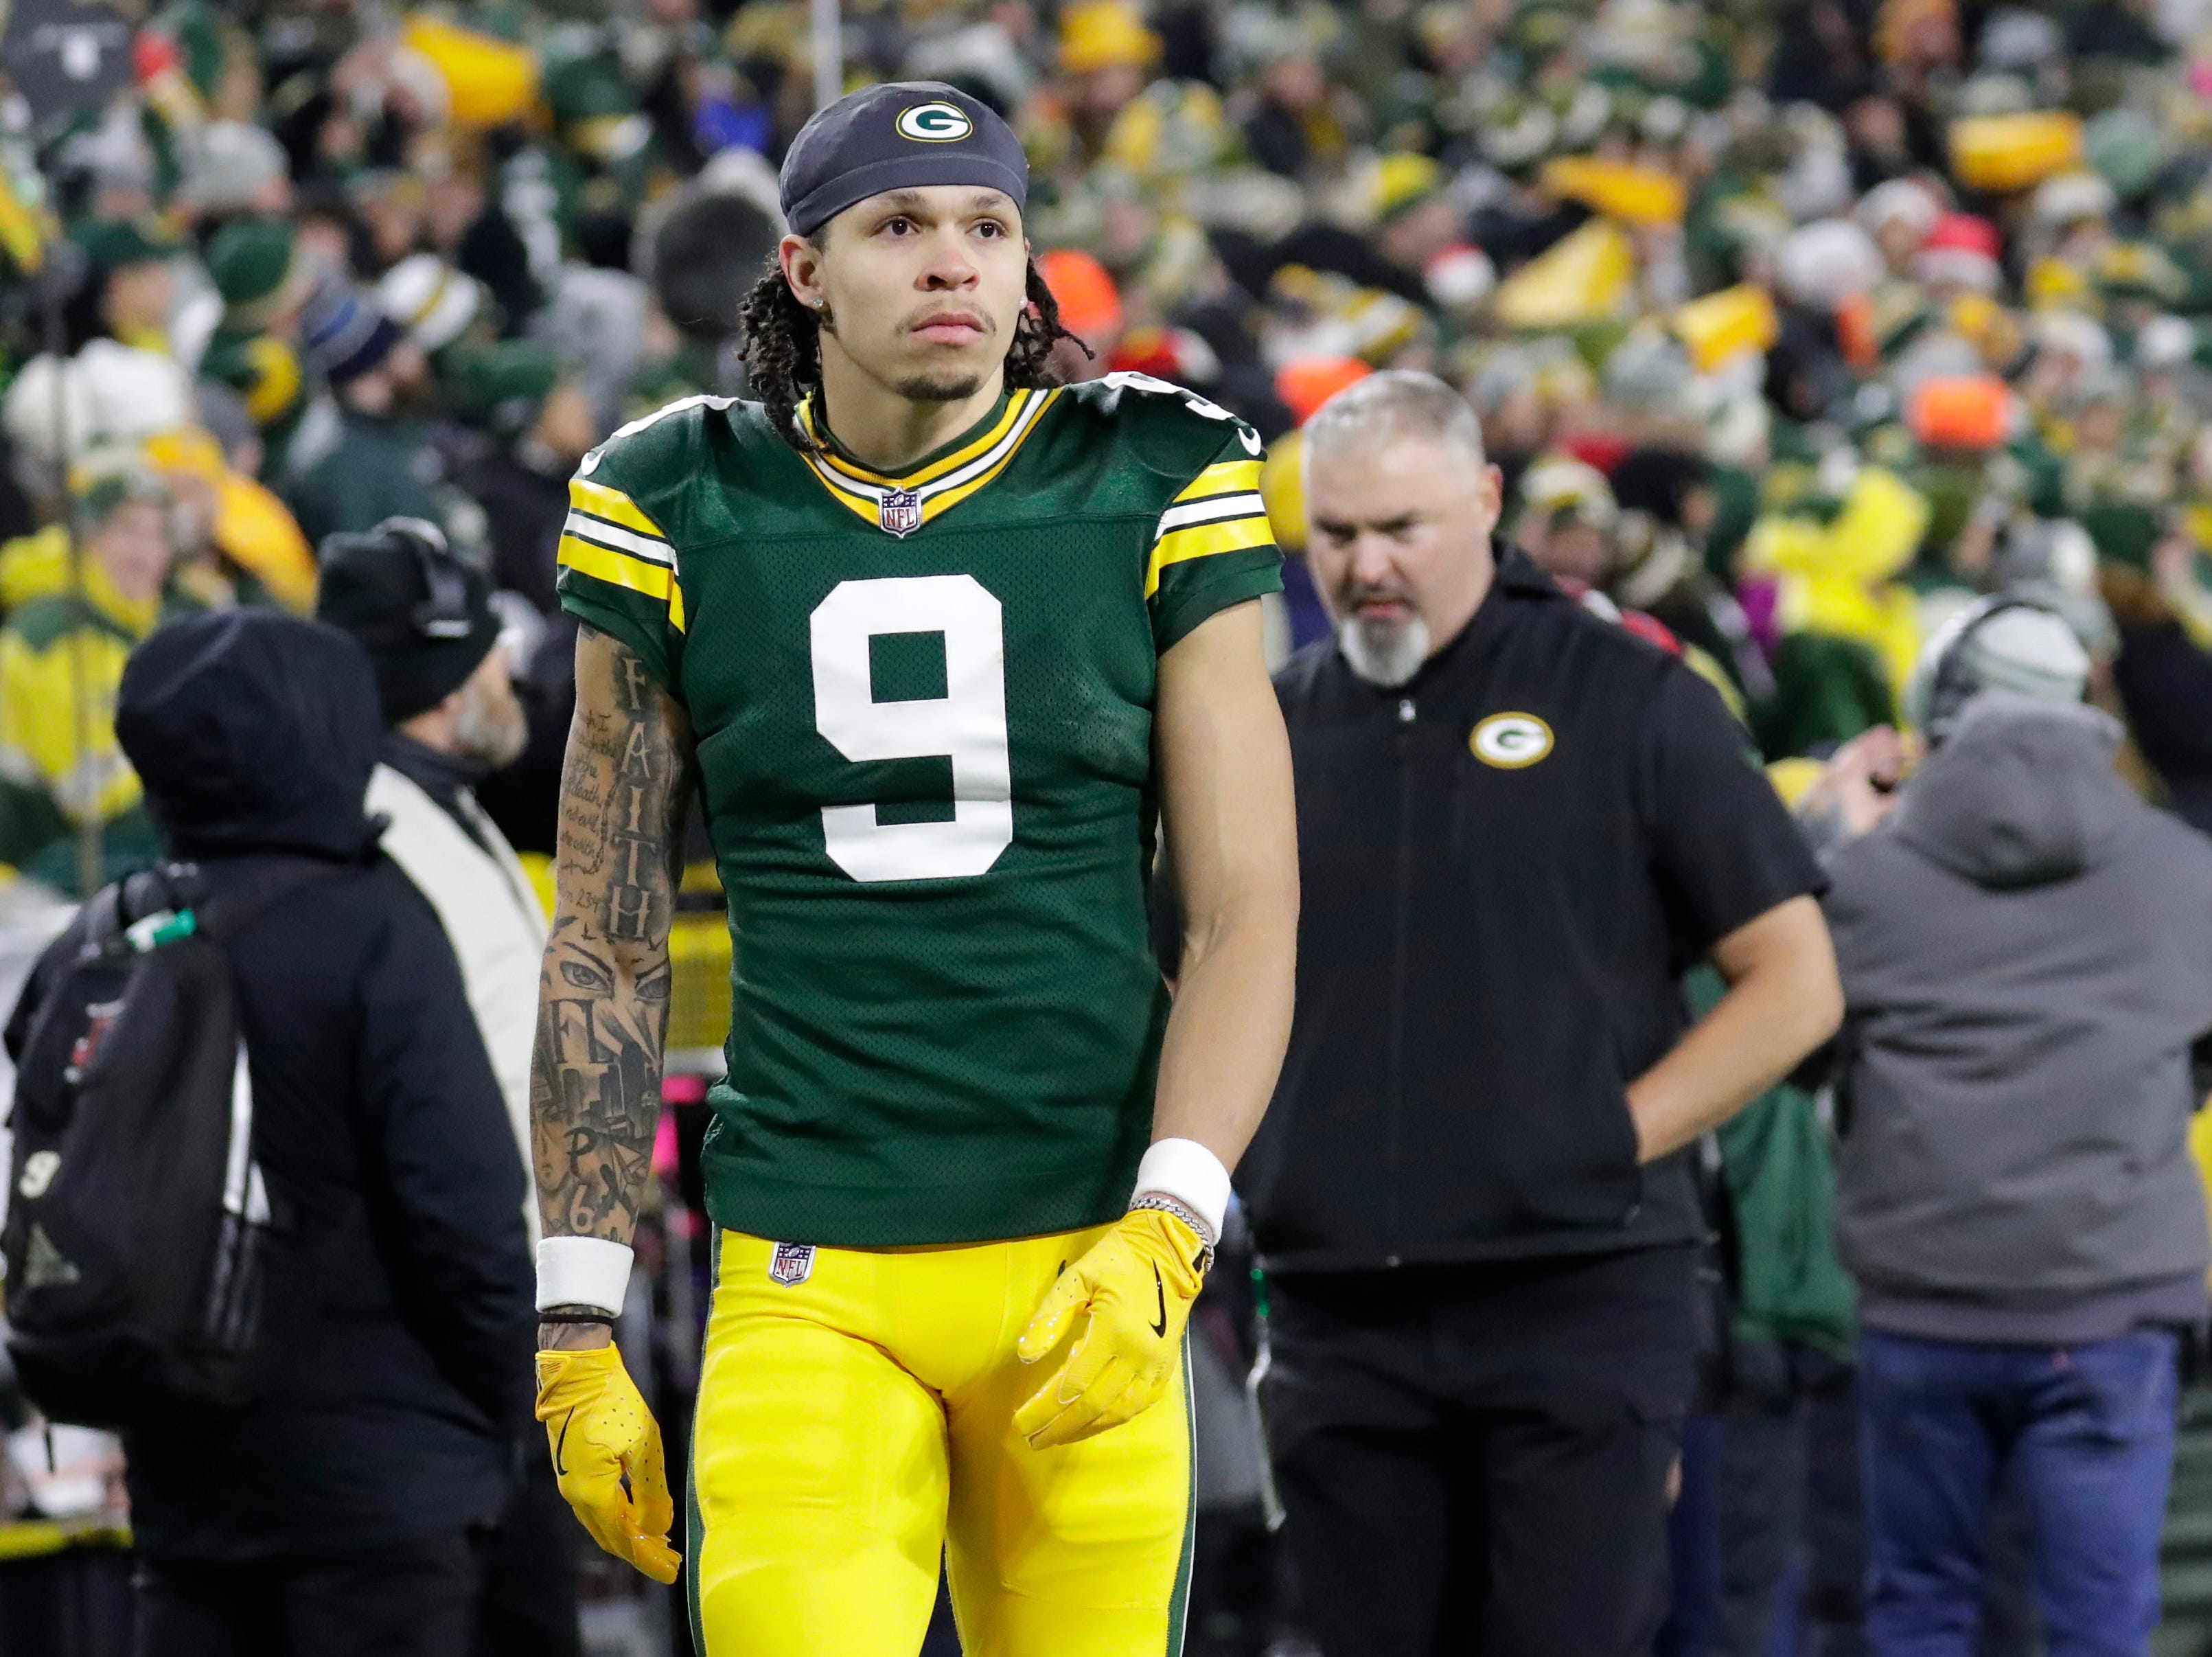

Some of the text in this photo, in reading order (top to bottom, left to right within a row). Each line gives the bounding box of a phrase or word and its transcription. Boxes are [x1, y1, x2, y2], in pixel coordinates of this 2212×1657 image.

[901, 104, 969, 139] G
[886, 508, 914, 529] NFL
[810, 574, 1013, 882] 9
[1477, 718, 1546, 762] G
[776, 1259, 803, 1278] NFL
